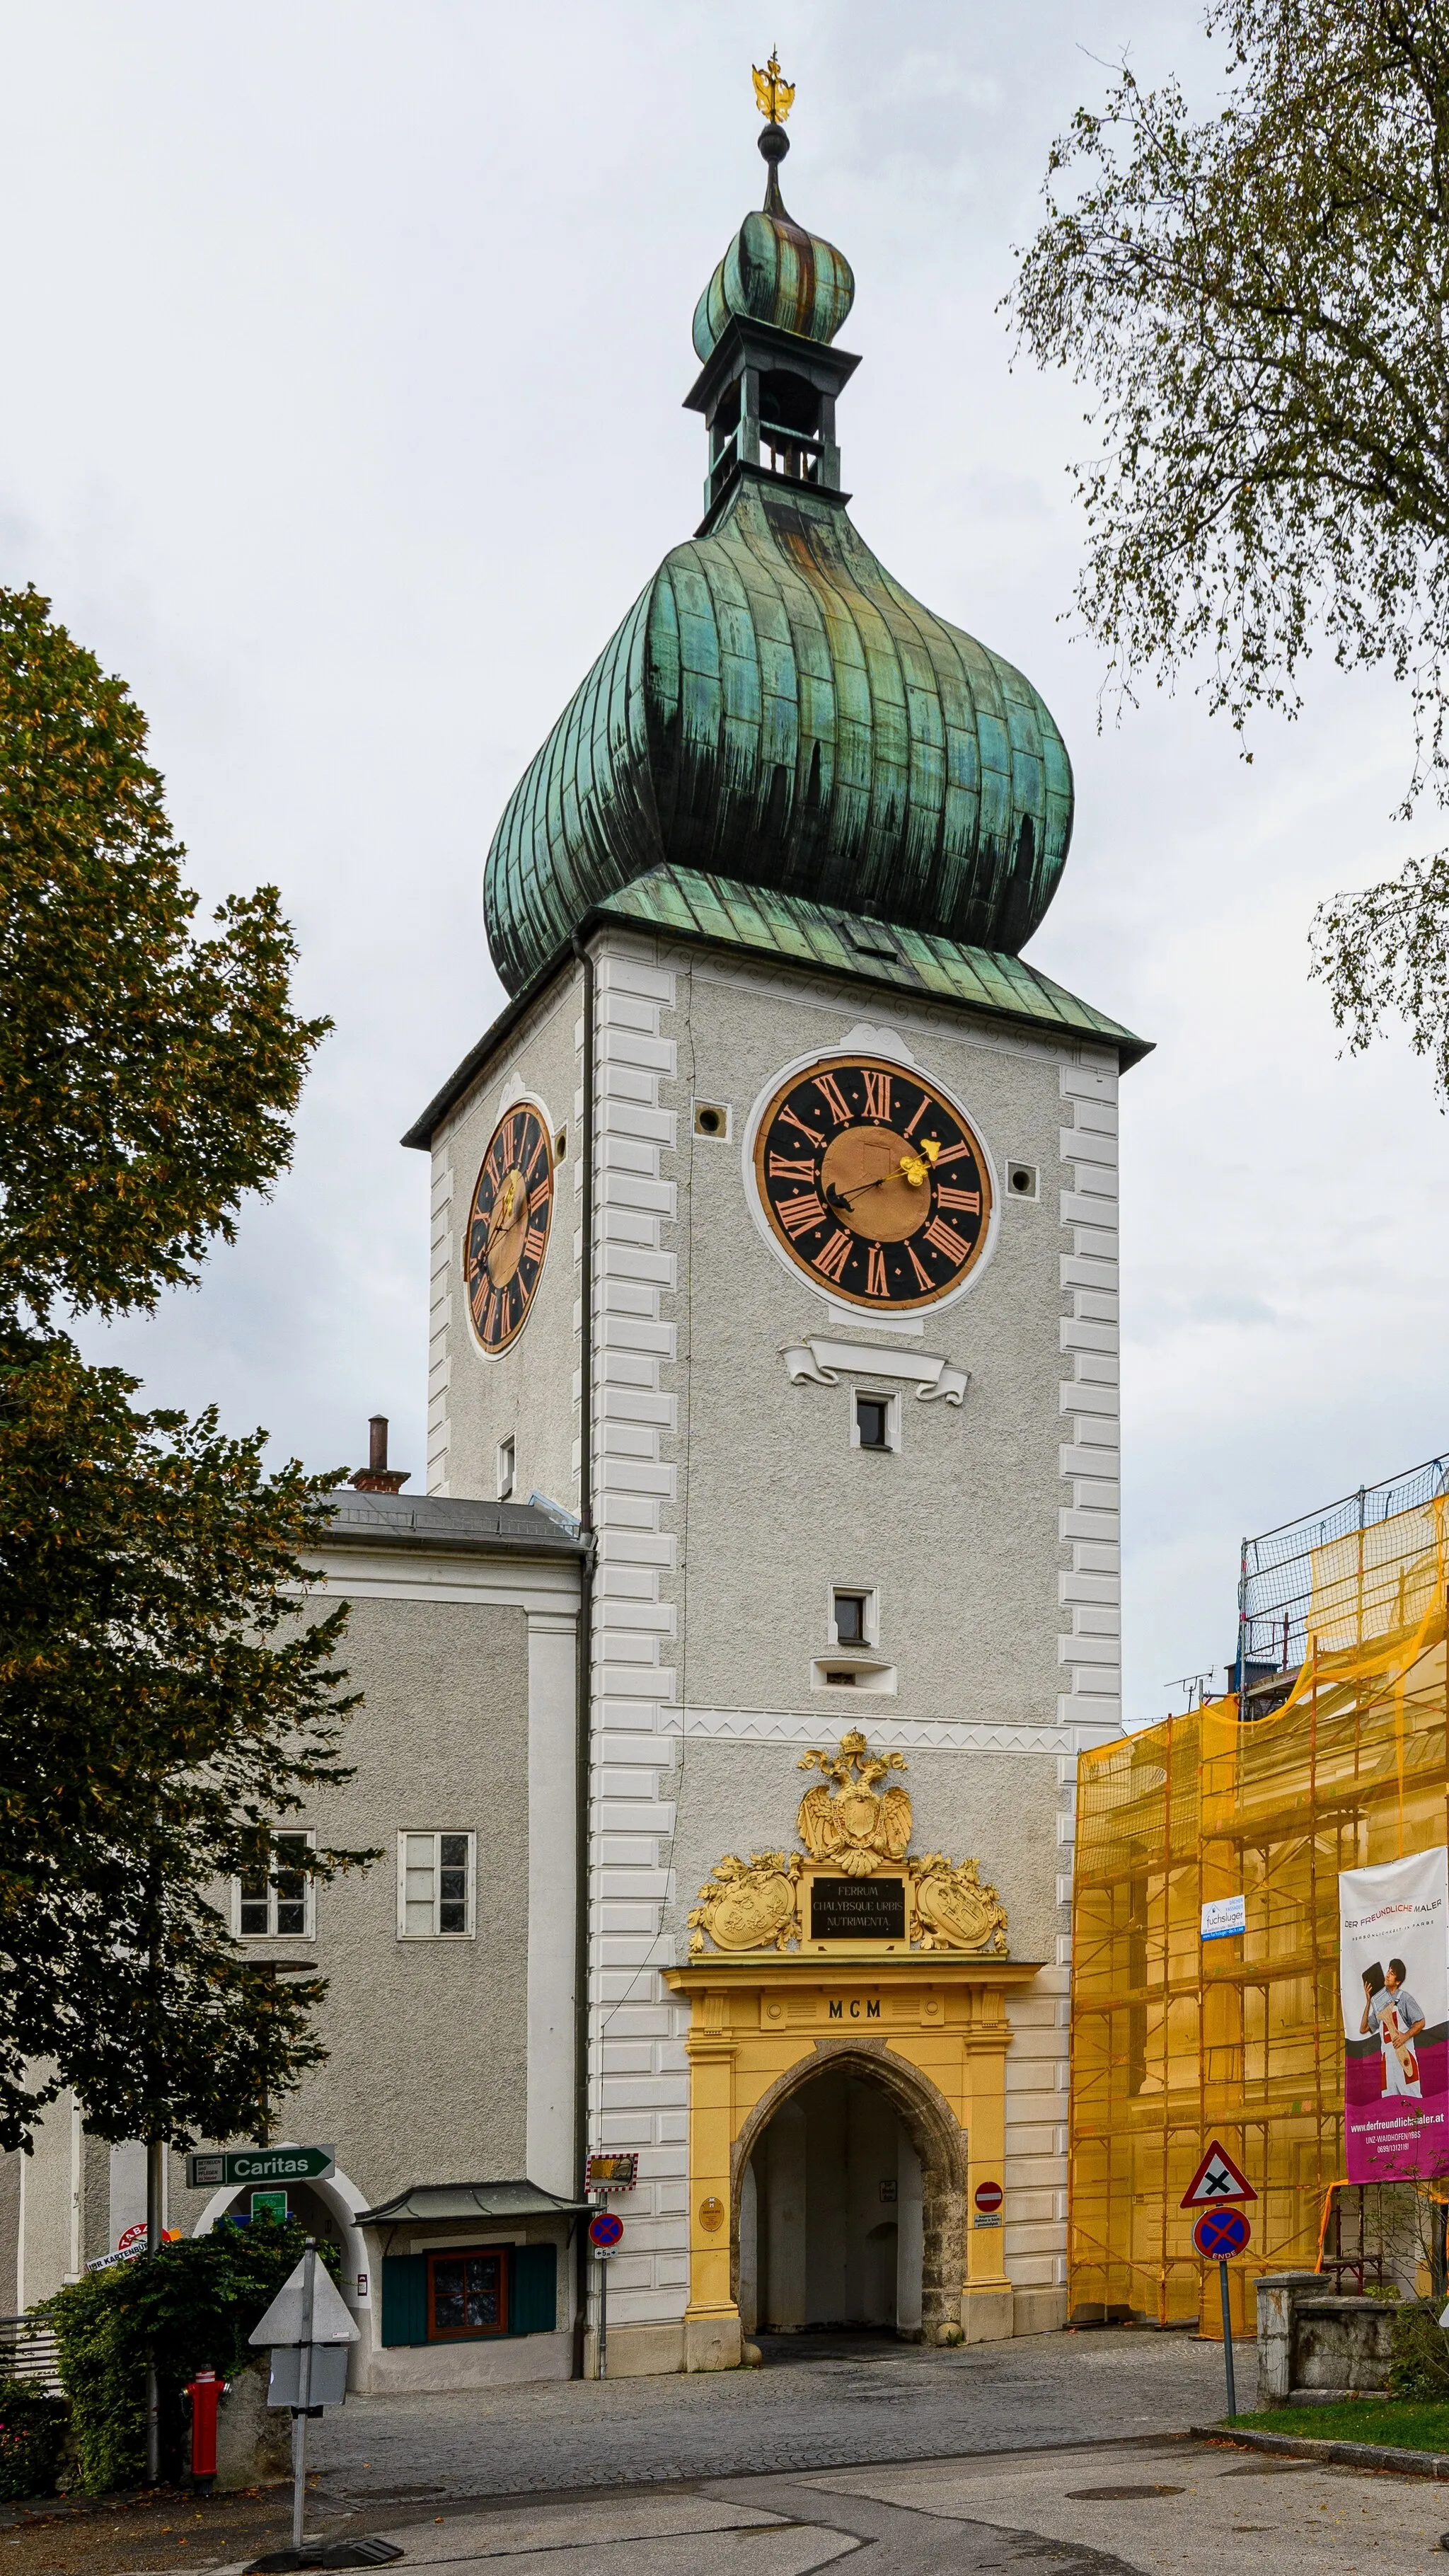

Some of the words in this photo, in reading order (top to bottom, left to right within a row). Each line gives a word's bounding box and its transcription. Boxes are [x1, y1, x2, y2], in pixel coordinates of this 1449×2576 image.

[812, 1073, 853, 1125] XI
[861, 1070, 892, 1122] XII
[778, 1105, 825, 1147] X
[905, 1095, 932, 1136] I
[769, 1150, 814, 1184] IX
[775, 1191, 827, 1241] VIII
[937, 1183, 980, 1215] III
[812, 1229, 853, 1283] VII
[923, 1215, 971, 1267] IIII
[865, 1246, 890, 1296] VI
[907, 1246, 935, 1291] V
[813, 1902, 874, 1911] CHALYBSQUE
[877, 1902, 904, 1911] URBIS
[838, 1886, 878, 1896] FERRUM
[1206, 1912, 1243, 1928] fuchsluger
[1344, 1920, 1358, 1928] DER
[1360, 1904, 1413, 1926] FREUNDLICHE
[1414, 1899, 1442, 1912] MALER
[1352, 1927, 1402, 1941] PERSÖNLICHKEIT
[829, 1999, 881, 2018] MCM
[234, 2157, 308, 2176] Caritas
[1212, 2250, 1237, 2260] ENDE
